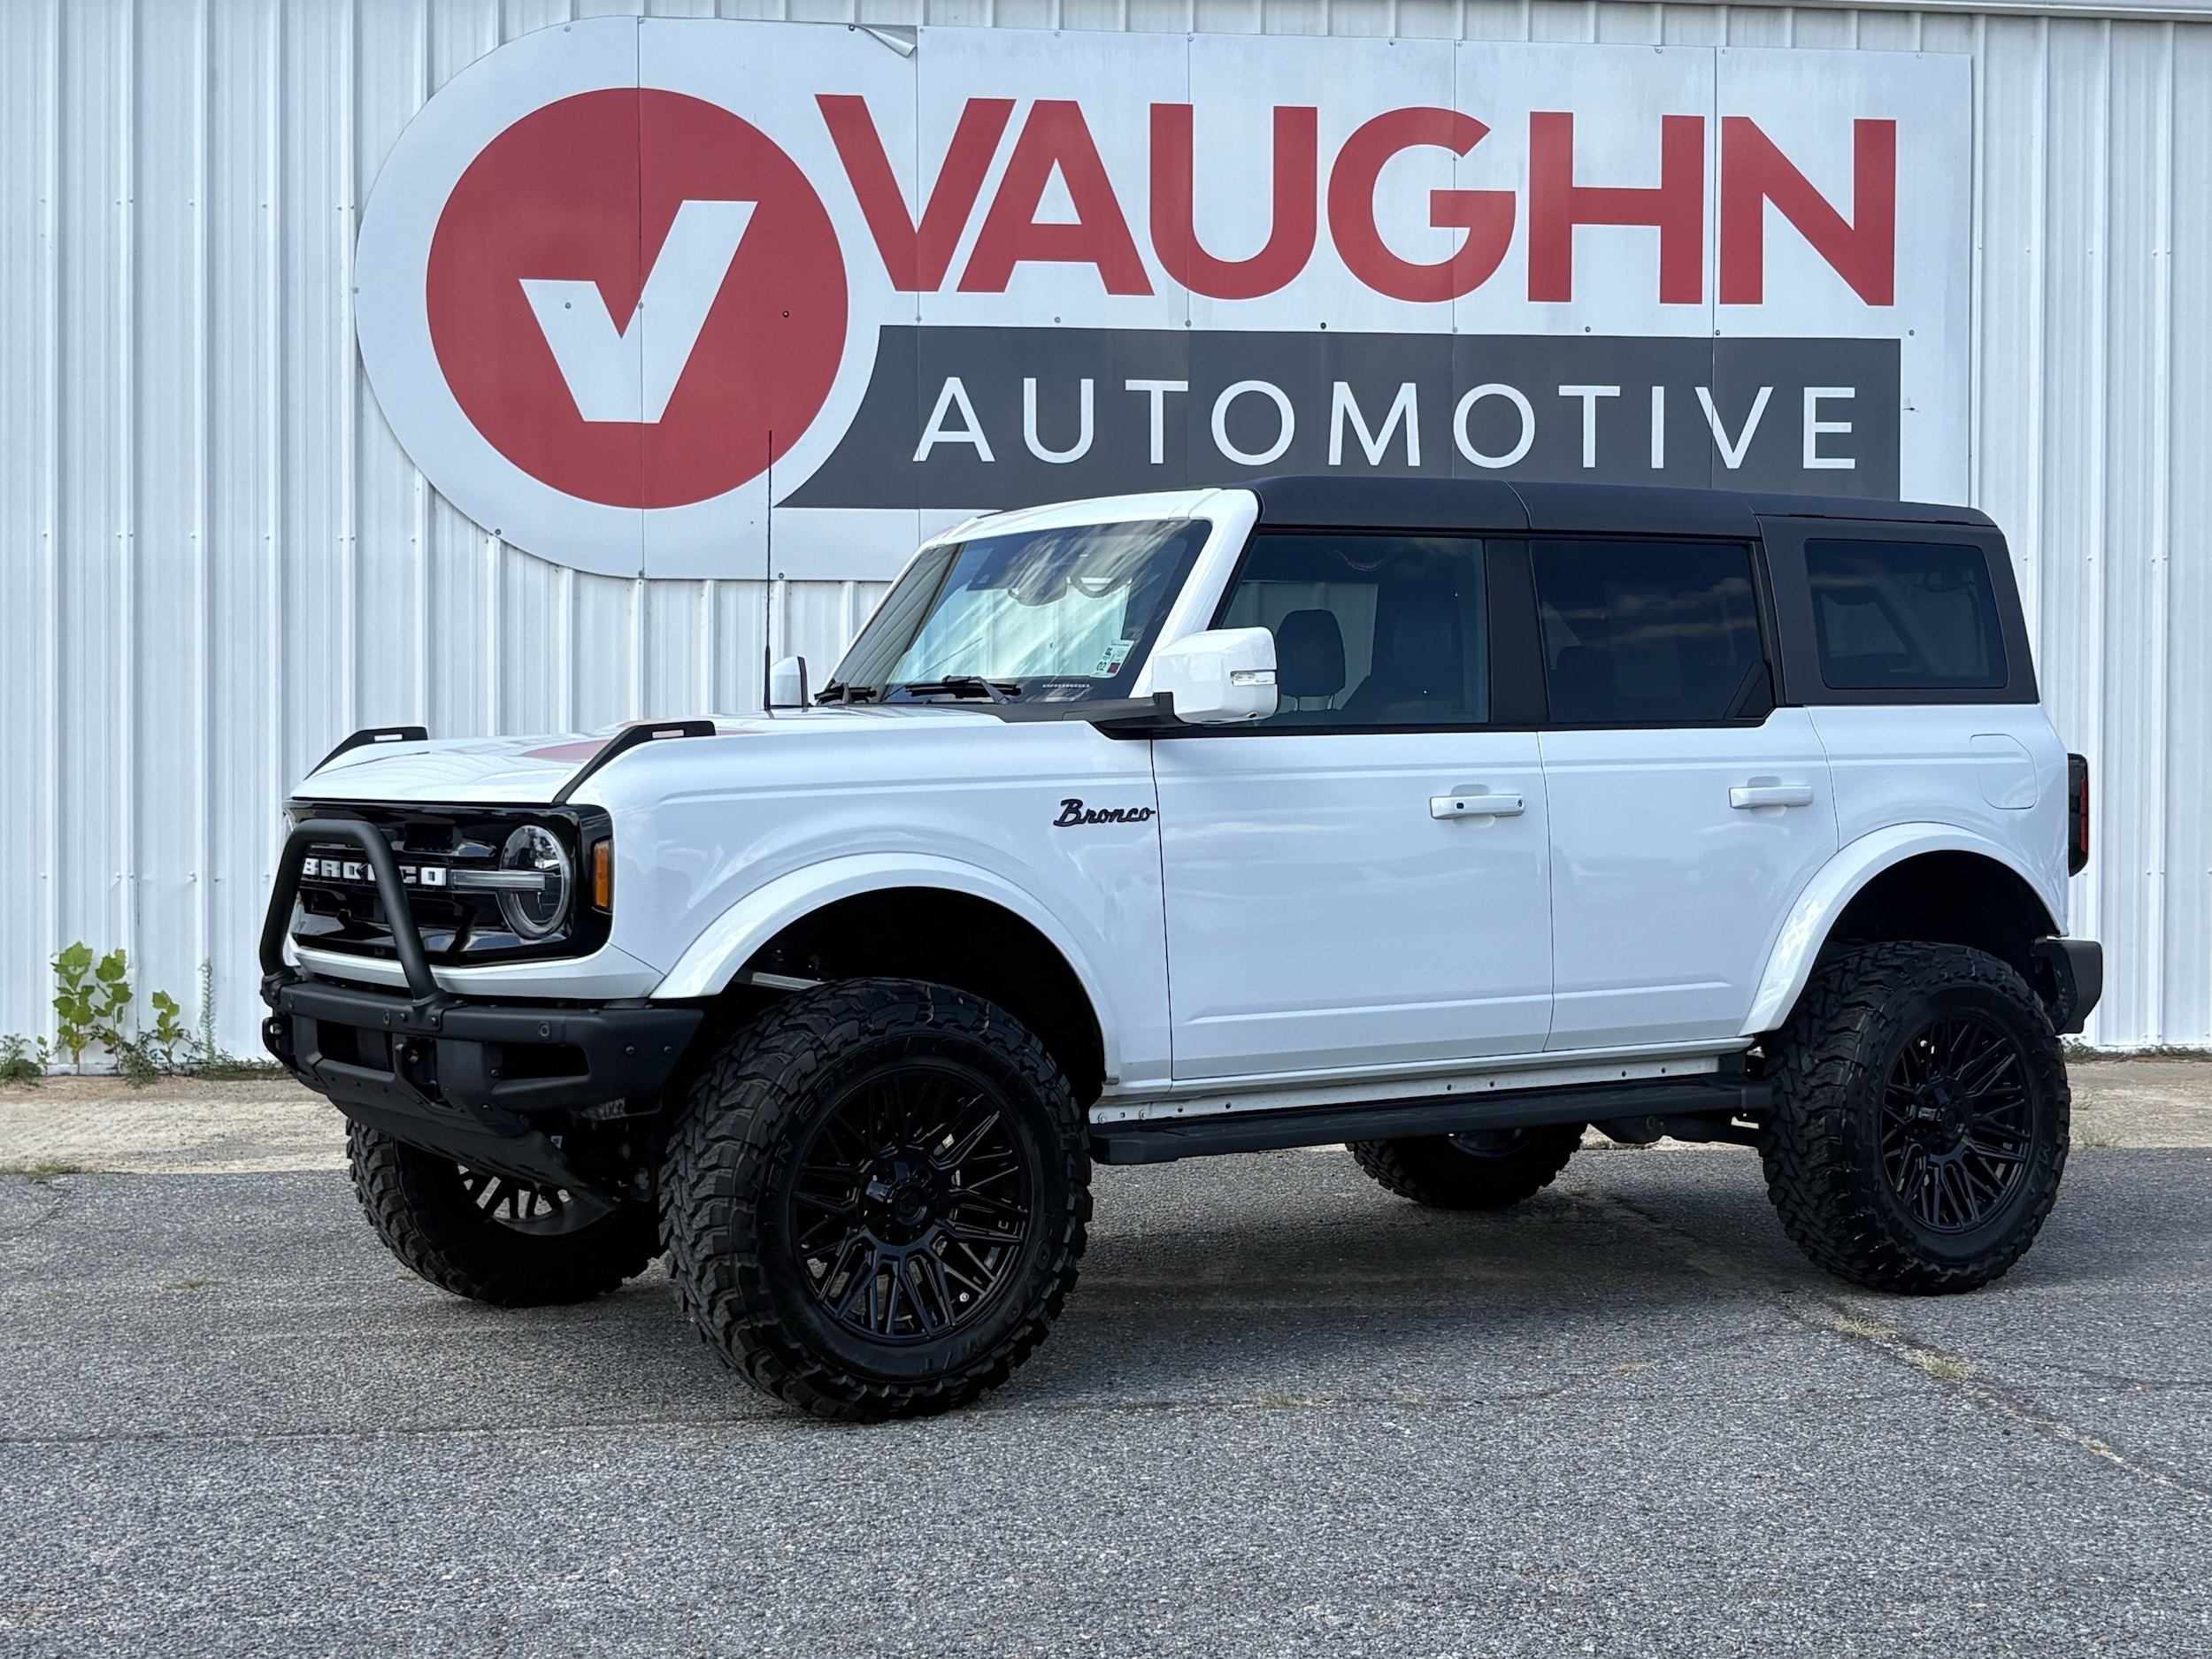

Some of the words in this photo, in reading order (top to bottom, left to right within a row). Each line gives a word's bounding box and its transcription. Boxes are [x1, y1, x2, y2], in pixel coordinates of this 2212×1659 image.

[818, 96, 1894, 304] VAUGHN
[913, 377, 1855, 469] AUTOMOTIVE
[1053, 799, 1156, 827] Bronco
